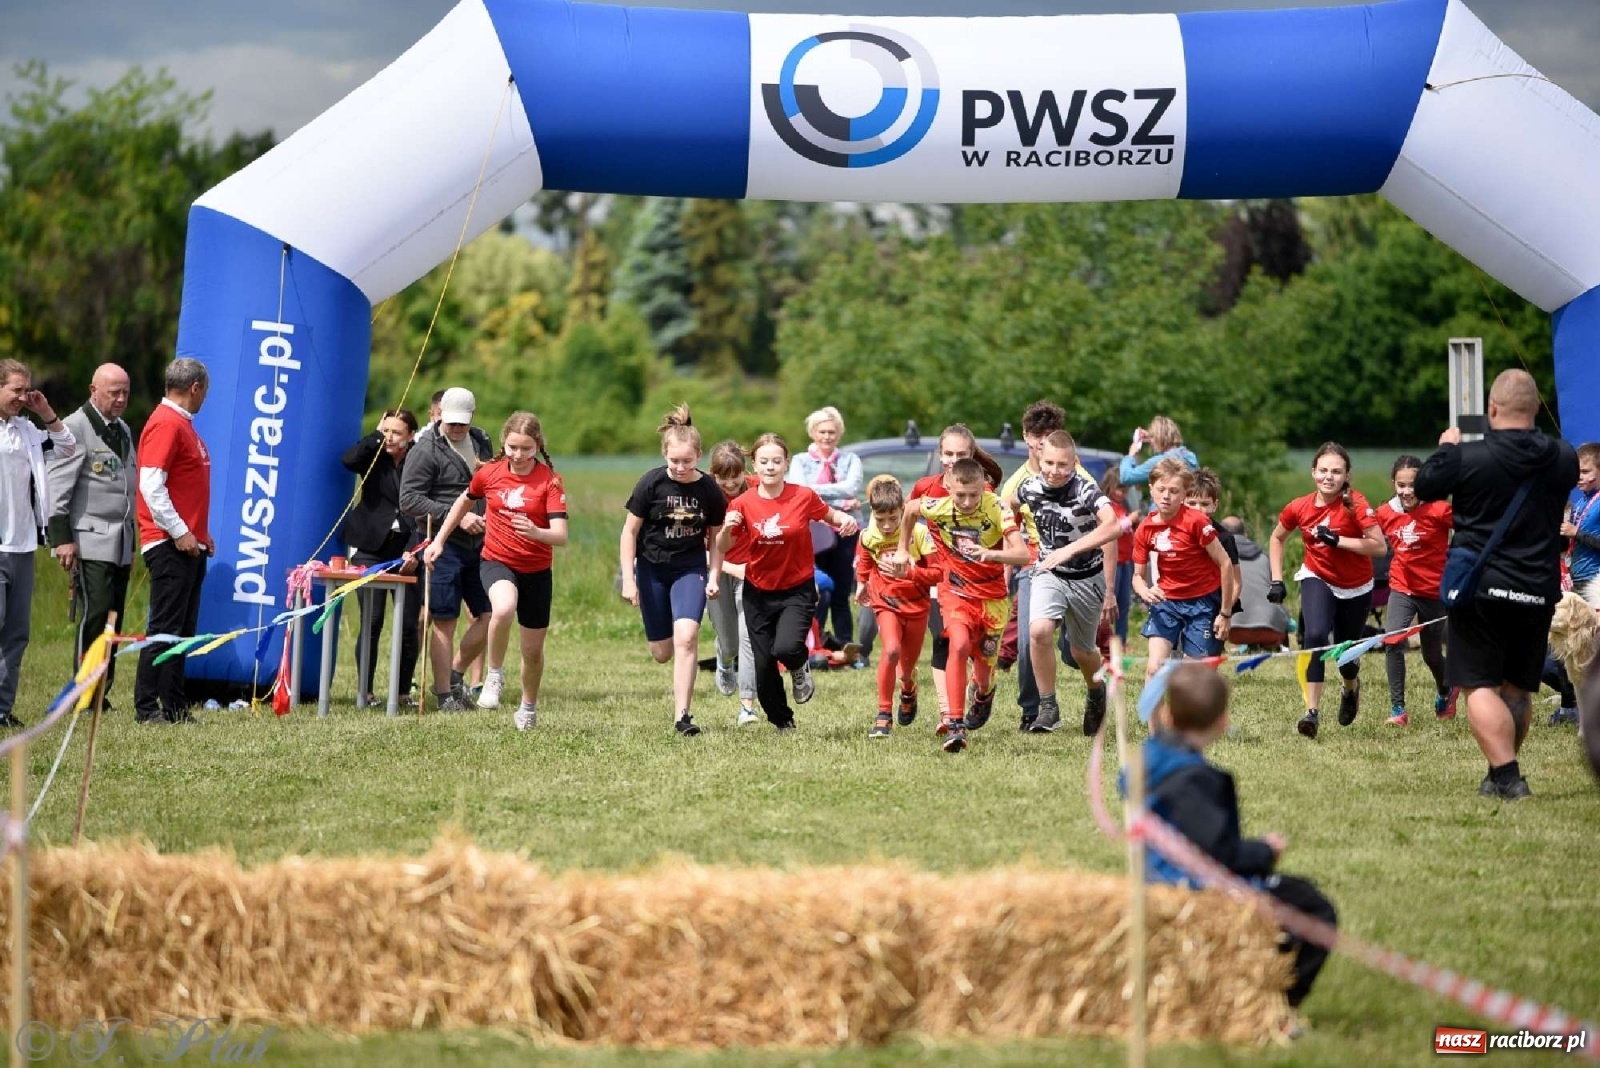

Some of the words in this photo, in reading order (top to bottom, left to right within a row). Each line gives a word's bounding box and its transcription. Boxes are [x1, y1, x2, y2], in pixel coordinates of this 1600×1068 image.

[962, 88, 1176, 147] PWSZ
[961, 150, 989, 167] W
[1005, 149, 1174, 167] RACIBORZU
[233, 319, 301, 606] pwszrac.pl
[667, 496, 698, 508] HELLO
[1488, 587, 1508, 598] new
[1509, 590, 1545, 604] balance
